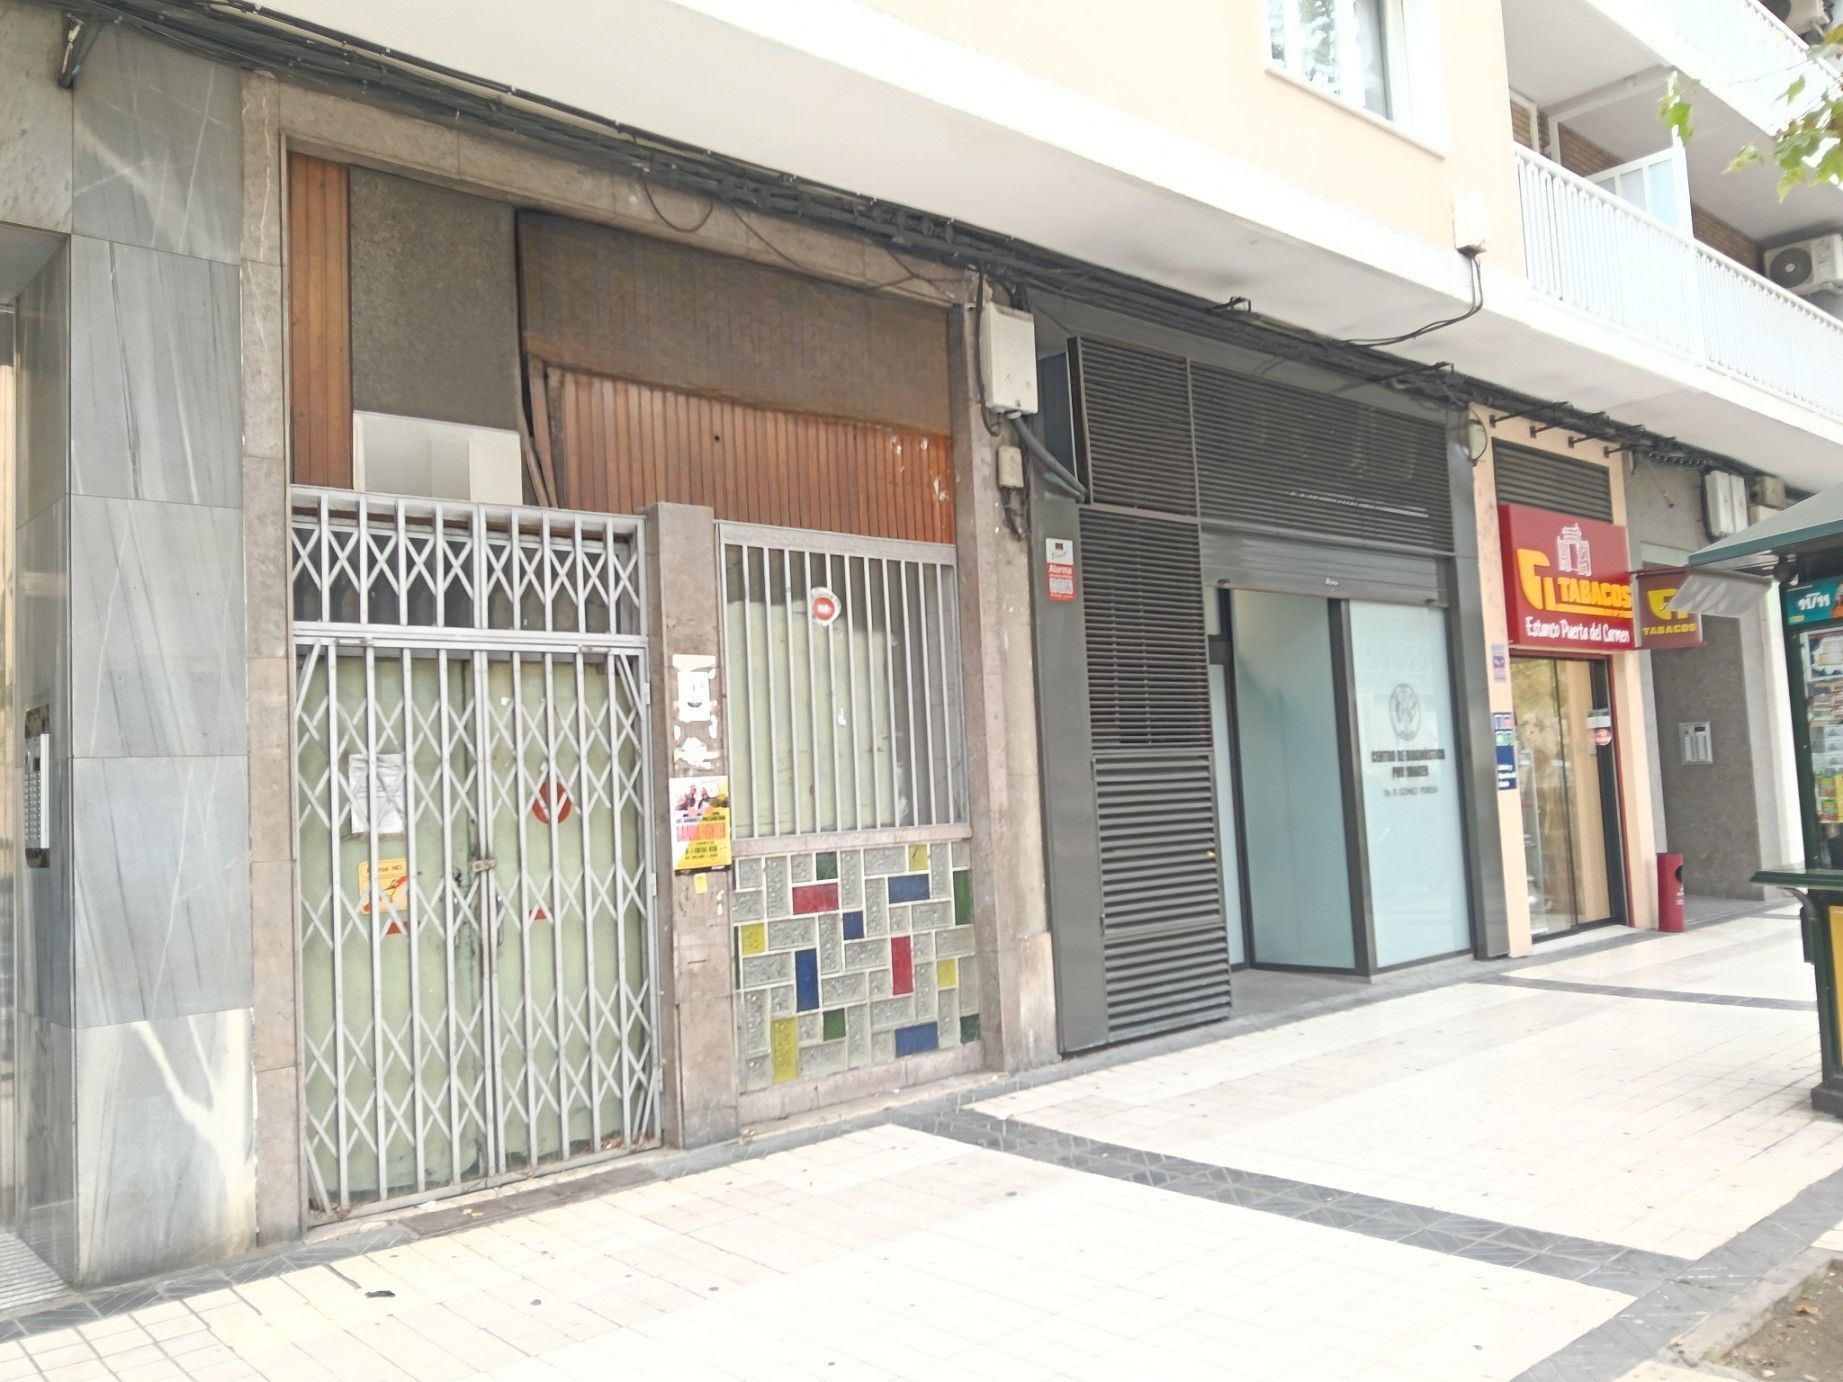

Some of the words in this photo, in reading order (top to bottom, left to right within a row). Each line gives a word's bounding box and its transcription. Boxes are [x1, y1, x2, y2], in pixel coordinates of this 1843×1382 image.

[1557, 577, 1633, 609] TABACOS
[1525, 616, 1559, 638] Estanco
[1559, 619, 1588, 641] Puerta
[1590, 622, 1601, 642] del
[1603, 623, 1630, 643] Carmen
[1642, 622, 1696, 635] TABACOS
